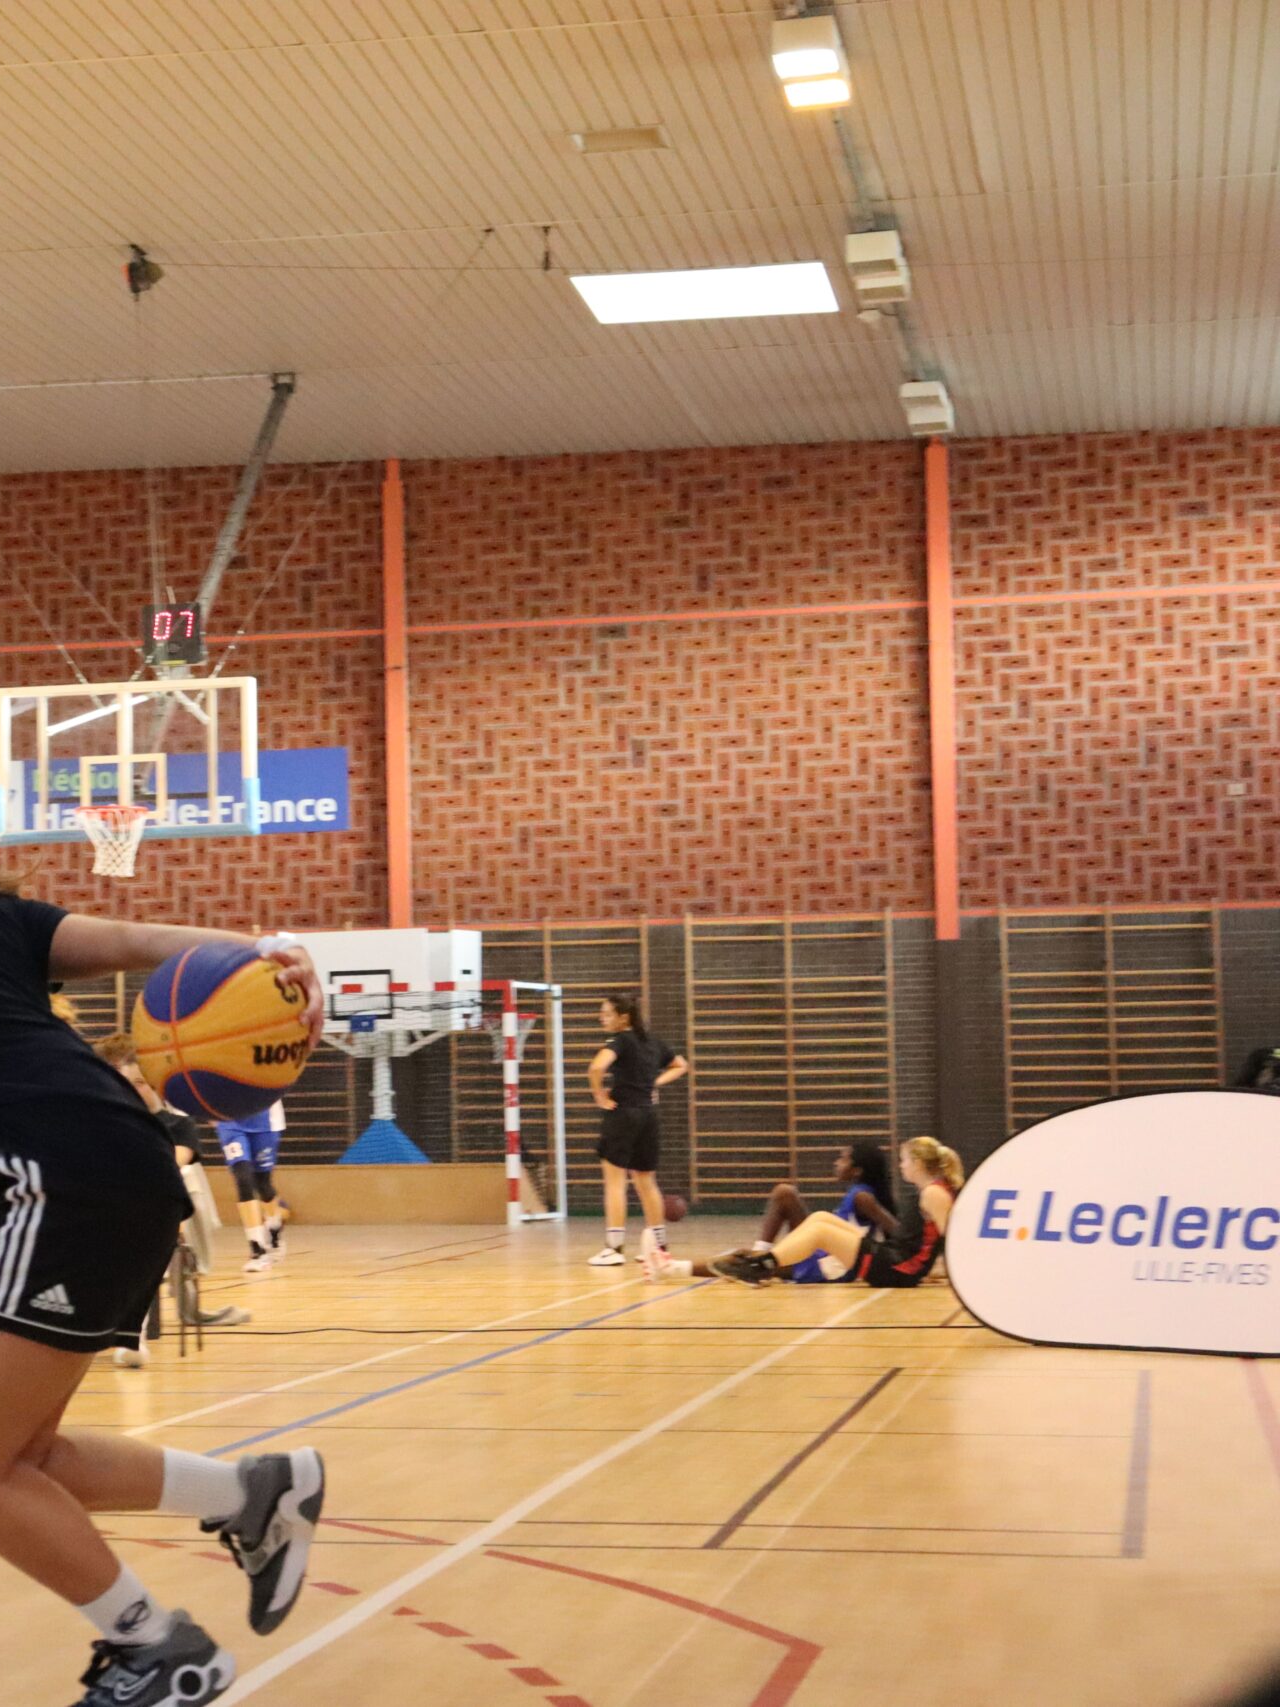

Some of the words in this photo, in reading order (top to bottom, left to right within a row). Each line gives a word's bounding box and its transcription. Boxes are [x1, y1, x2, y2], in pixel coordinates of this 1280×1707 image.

[152, 610, 194, 640] 07
[32, 767, 127, 796] Régio
[977, 1188, 1280, 1251] E.Leclerc
[1132, 1259, 1272, 1286] LILLE-FIVES
